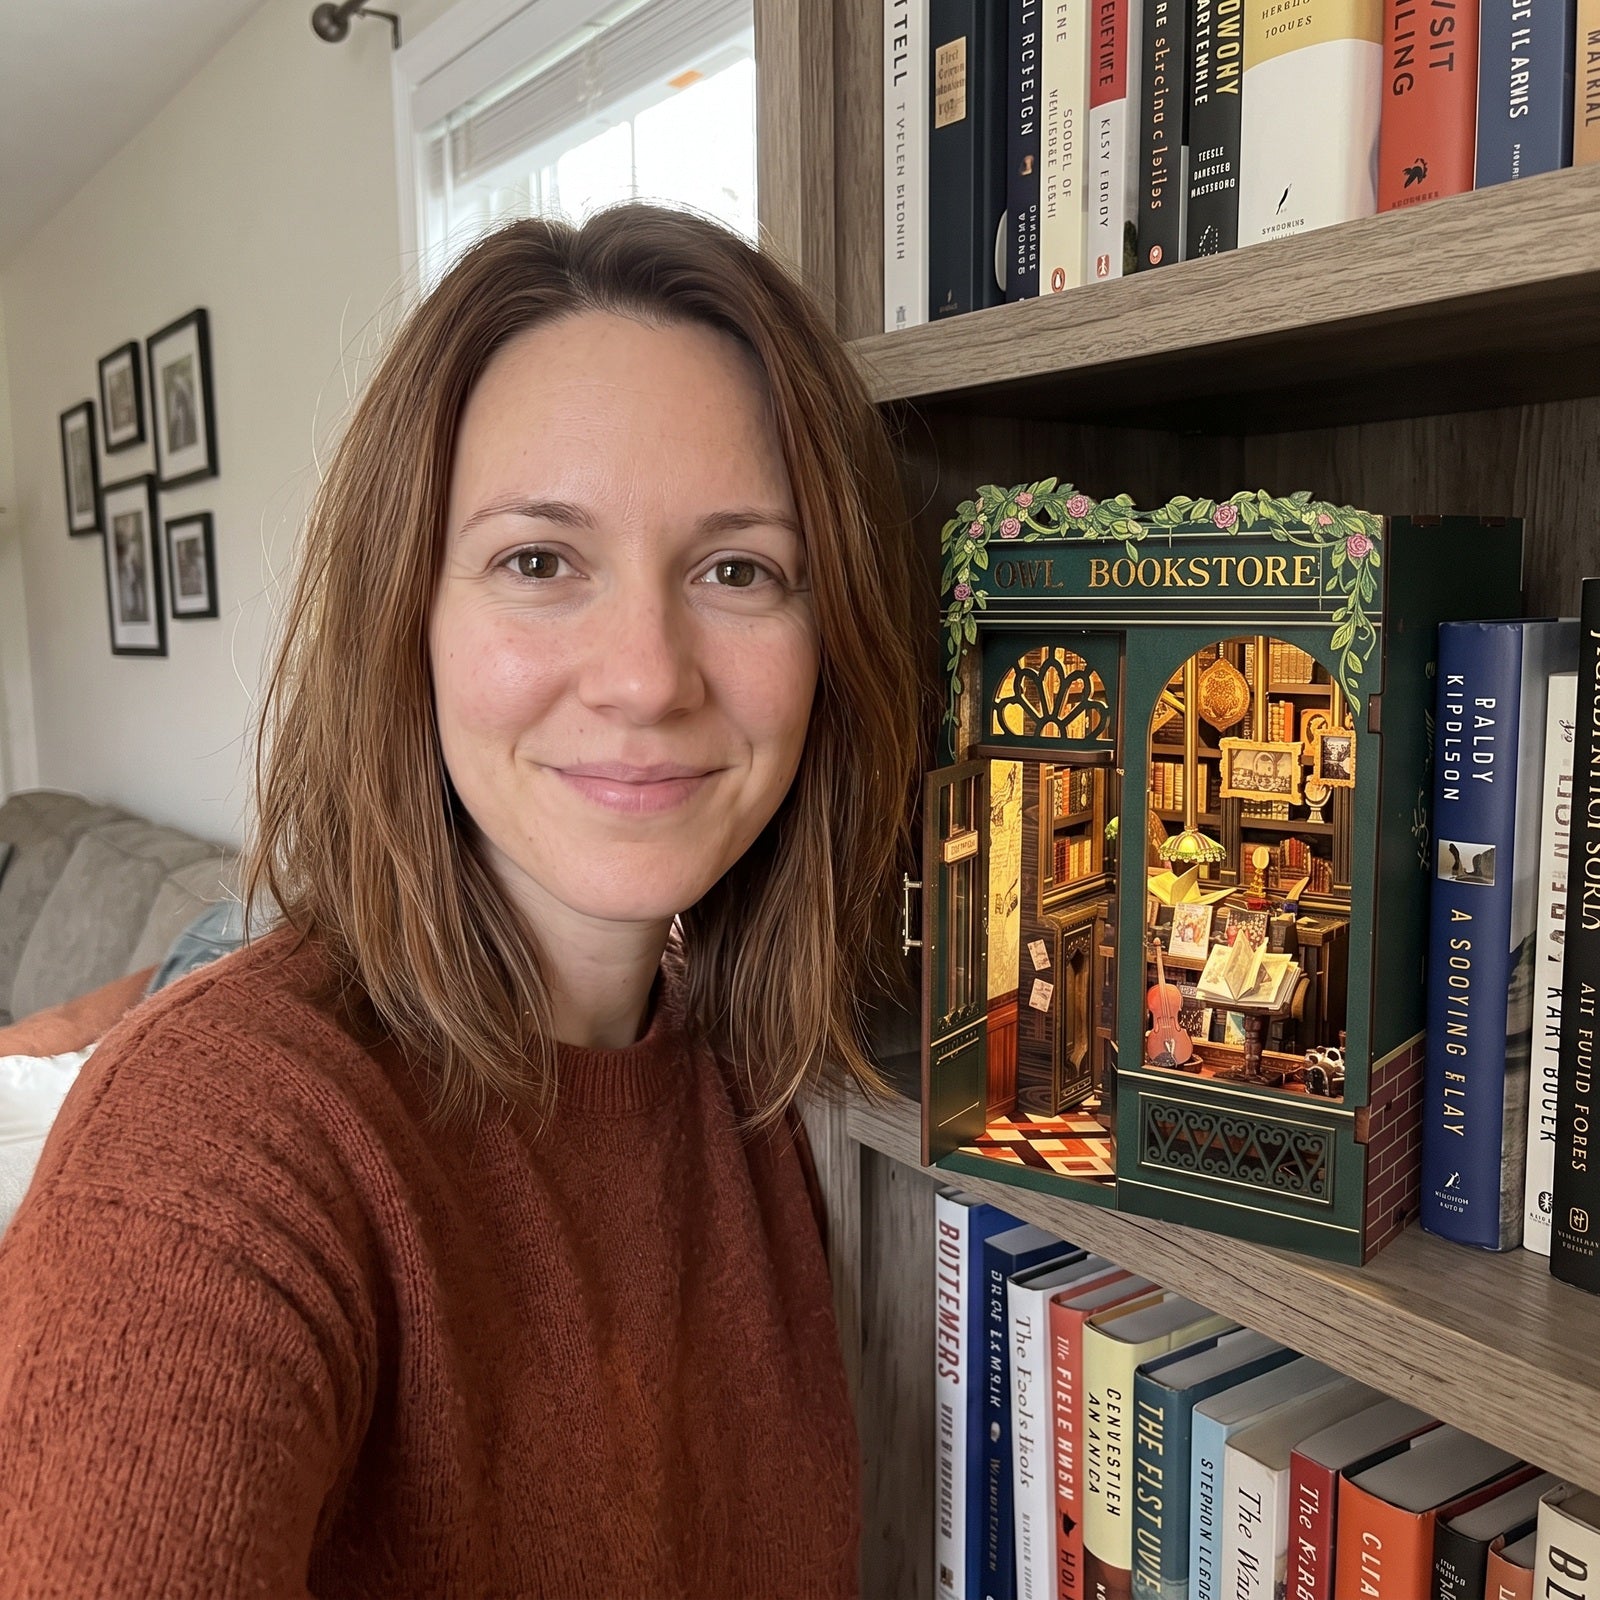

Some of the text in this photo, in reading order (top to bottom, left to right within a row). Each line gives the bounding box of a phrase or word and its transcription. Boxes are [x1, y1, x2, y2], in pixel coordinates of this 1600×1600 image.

[994, 555, 1318, 590] OWL BOOKSTORE
[1443, 674, 1465, 800] KIPDLSON
[1451, 908, 1472, 922] A
[1446, 938, 1472, 1056] SOOYING
[938, 1219, 960, 1385] BUTTEMERS
[1015, 1316, 1032, 1359] The
[1137, 1400, 1165, 1456] THE
[1238, 1487, 1263, 1539] The
[1299, 1483, 1320, 1530] The
